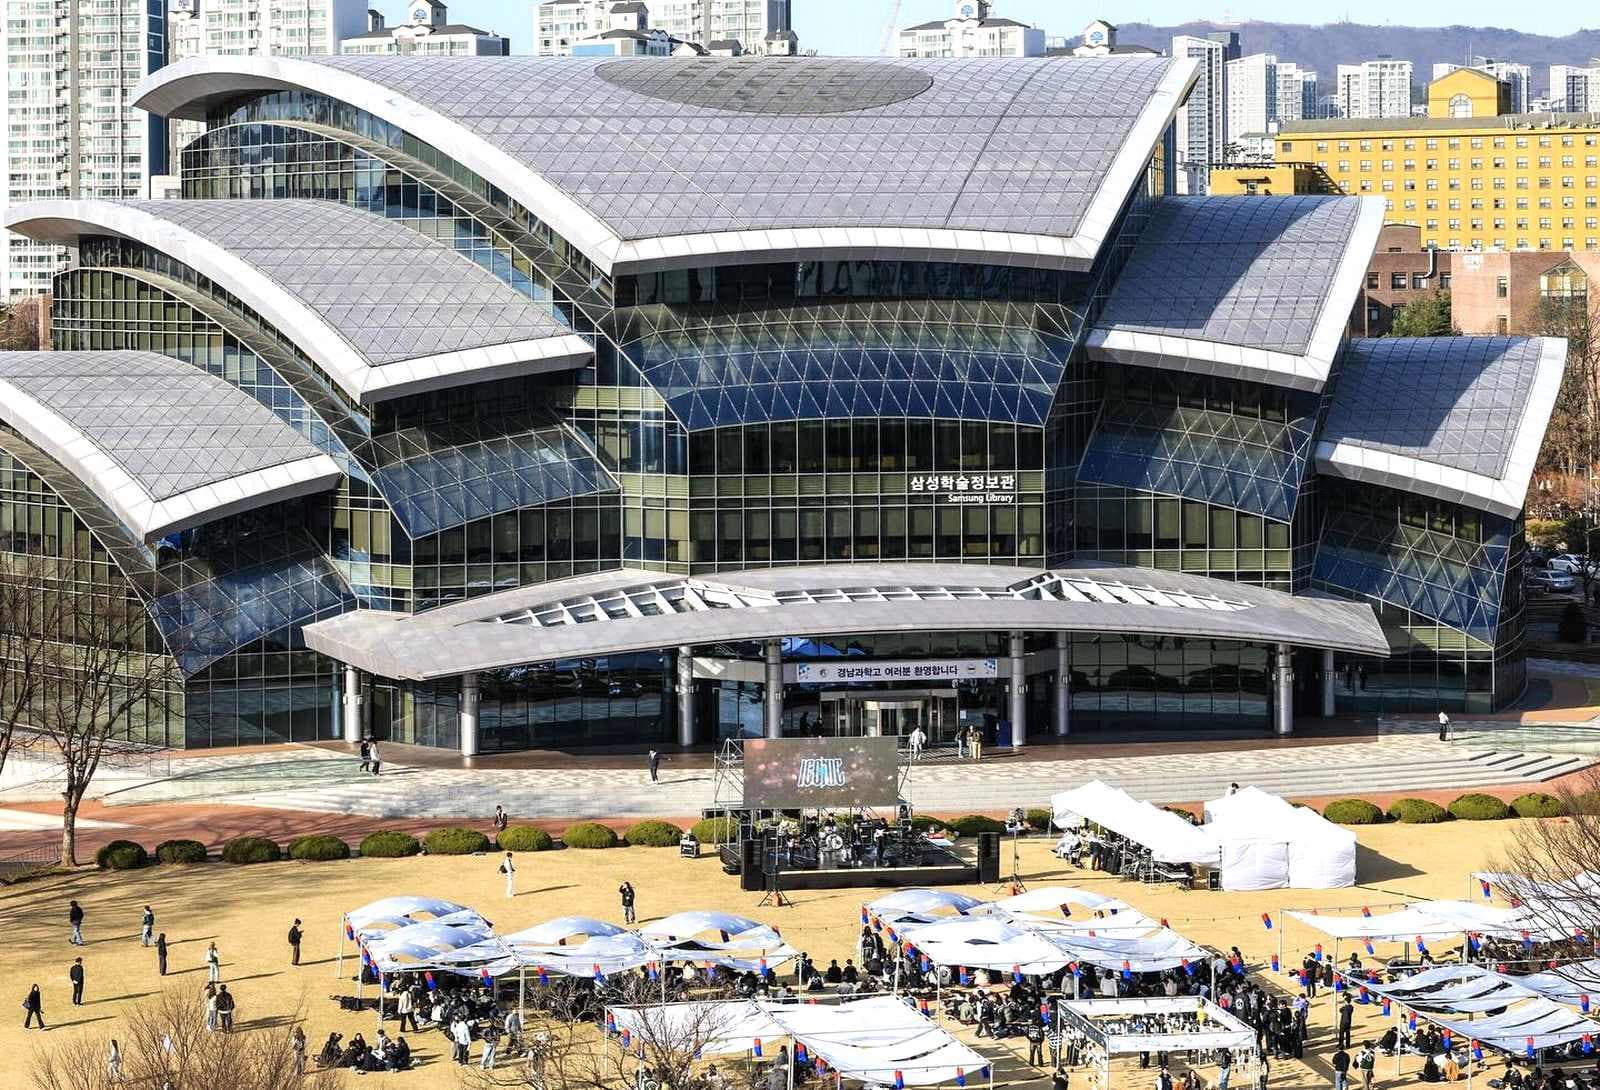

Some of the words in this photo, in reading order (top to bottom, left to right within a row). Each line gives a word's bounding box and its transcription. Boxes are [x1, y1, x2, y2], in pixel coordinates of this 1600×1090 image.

[910, 475, 1015, 491] 삼성학술정보관
[948, 494, 984, 504] Samsung
[986, 493, 1014, 503] Library
[837, 667, 882, 678] 경남과학고
[885, 666, 911, 677] 여러분
[914, 665, 959, 676] 환영합니다
